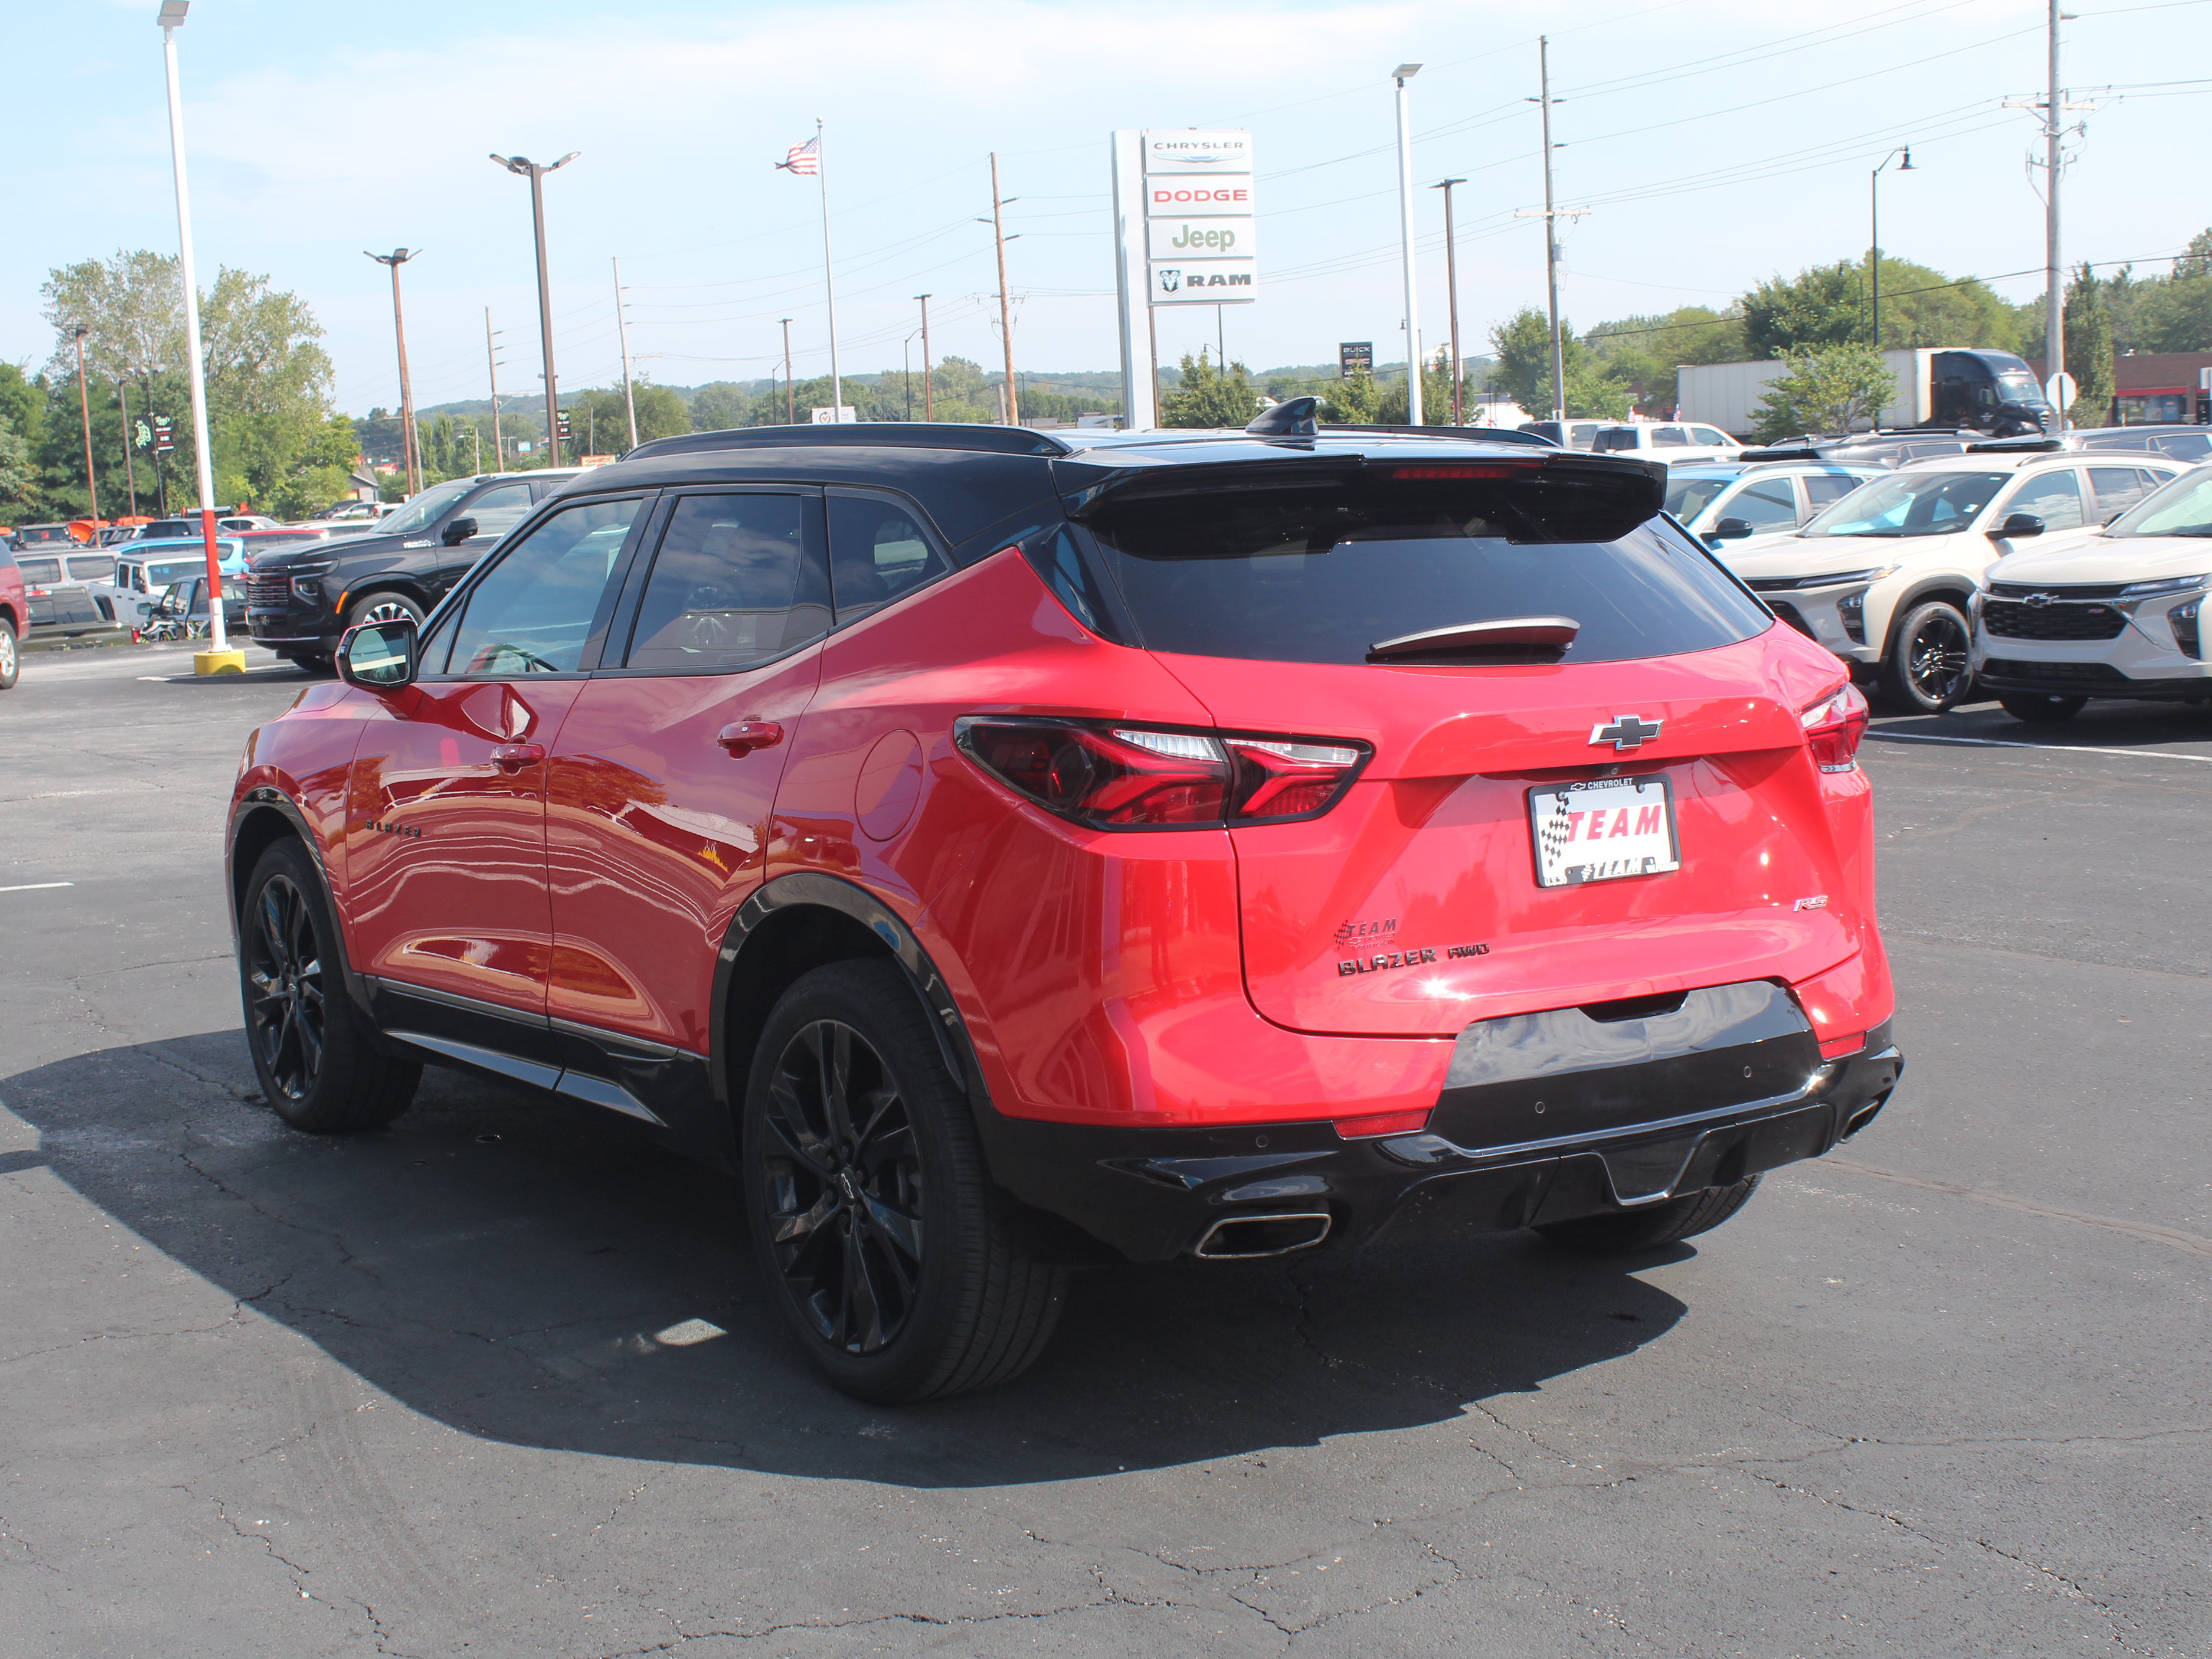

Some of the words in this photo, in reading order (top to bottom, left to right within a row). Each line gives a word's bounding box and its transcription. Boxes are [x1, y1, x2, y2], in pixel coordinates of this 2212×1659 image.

[1154, 189, 1248, 202] DODGE
[1172, 225, 1235, 252] Jeep
[1186, 274, 1251, 287] RAM
[1587, 778, 1633, 790] CHEVROLET
[366, 819, 421, 838] BLAZER
[1566, 805, 1662, 842] TEAM
[1593, 857, 1643, 878] TEAM
[1793, 895, 1828, 912] RS
[1348, 918, 1396, 937] TEAM
[1338, 948, 1437, 976] BLAZER
[1448, 943, 1490, 960] AWD
